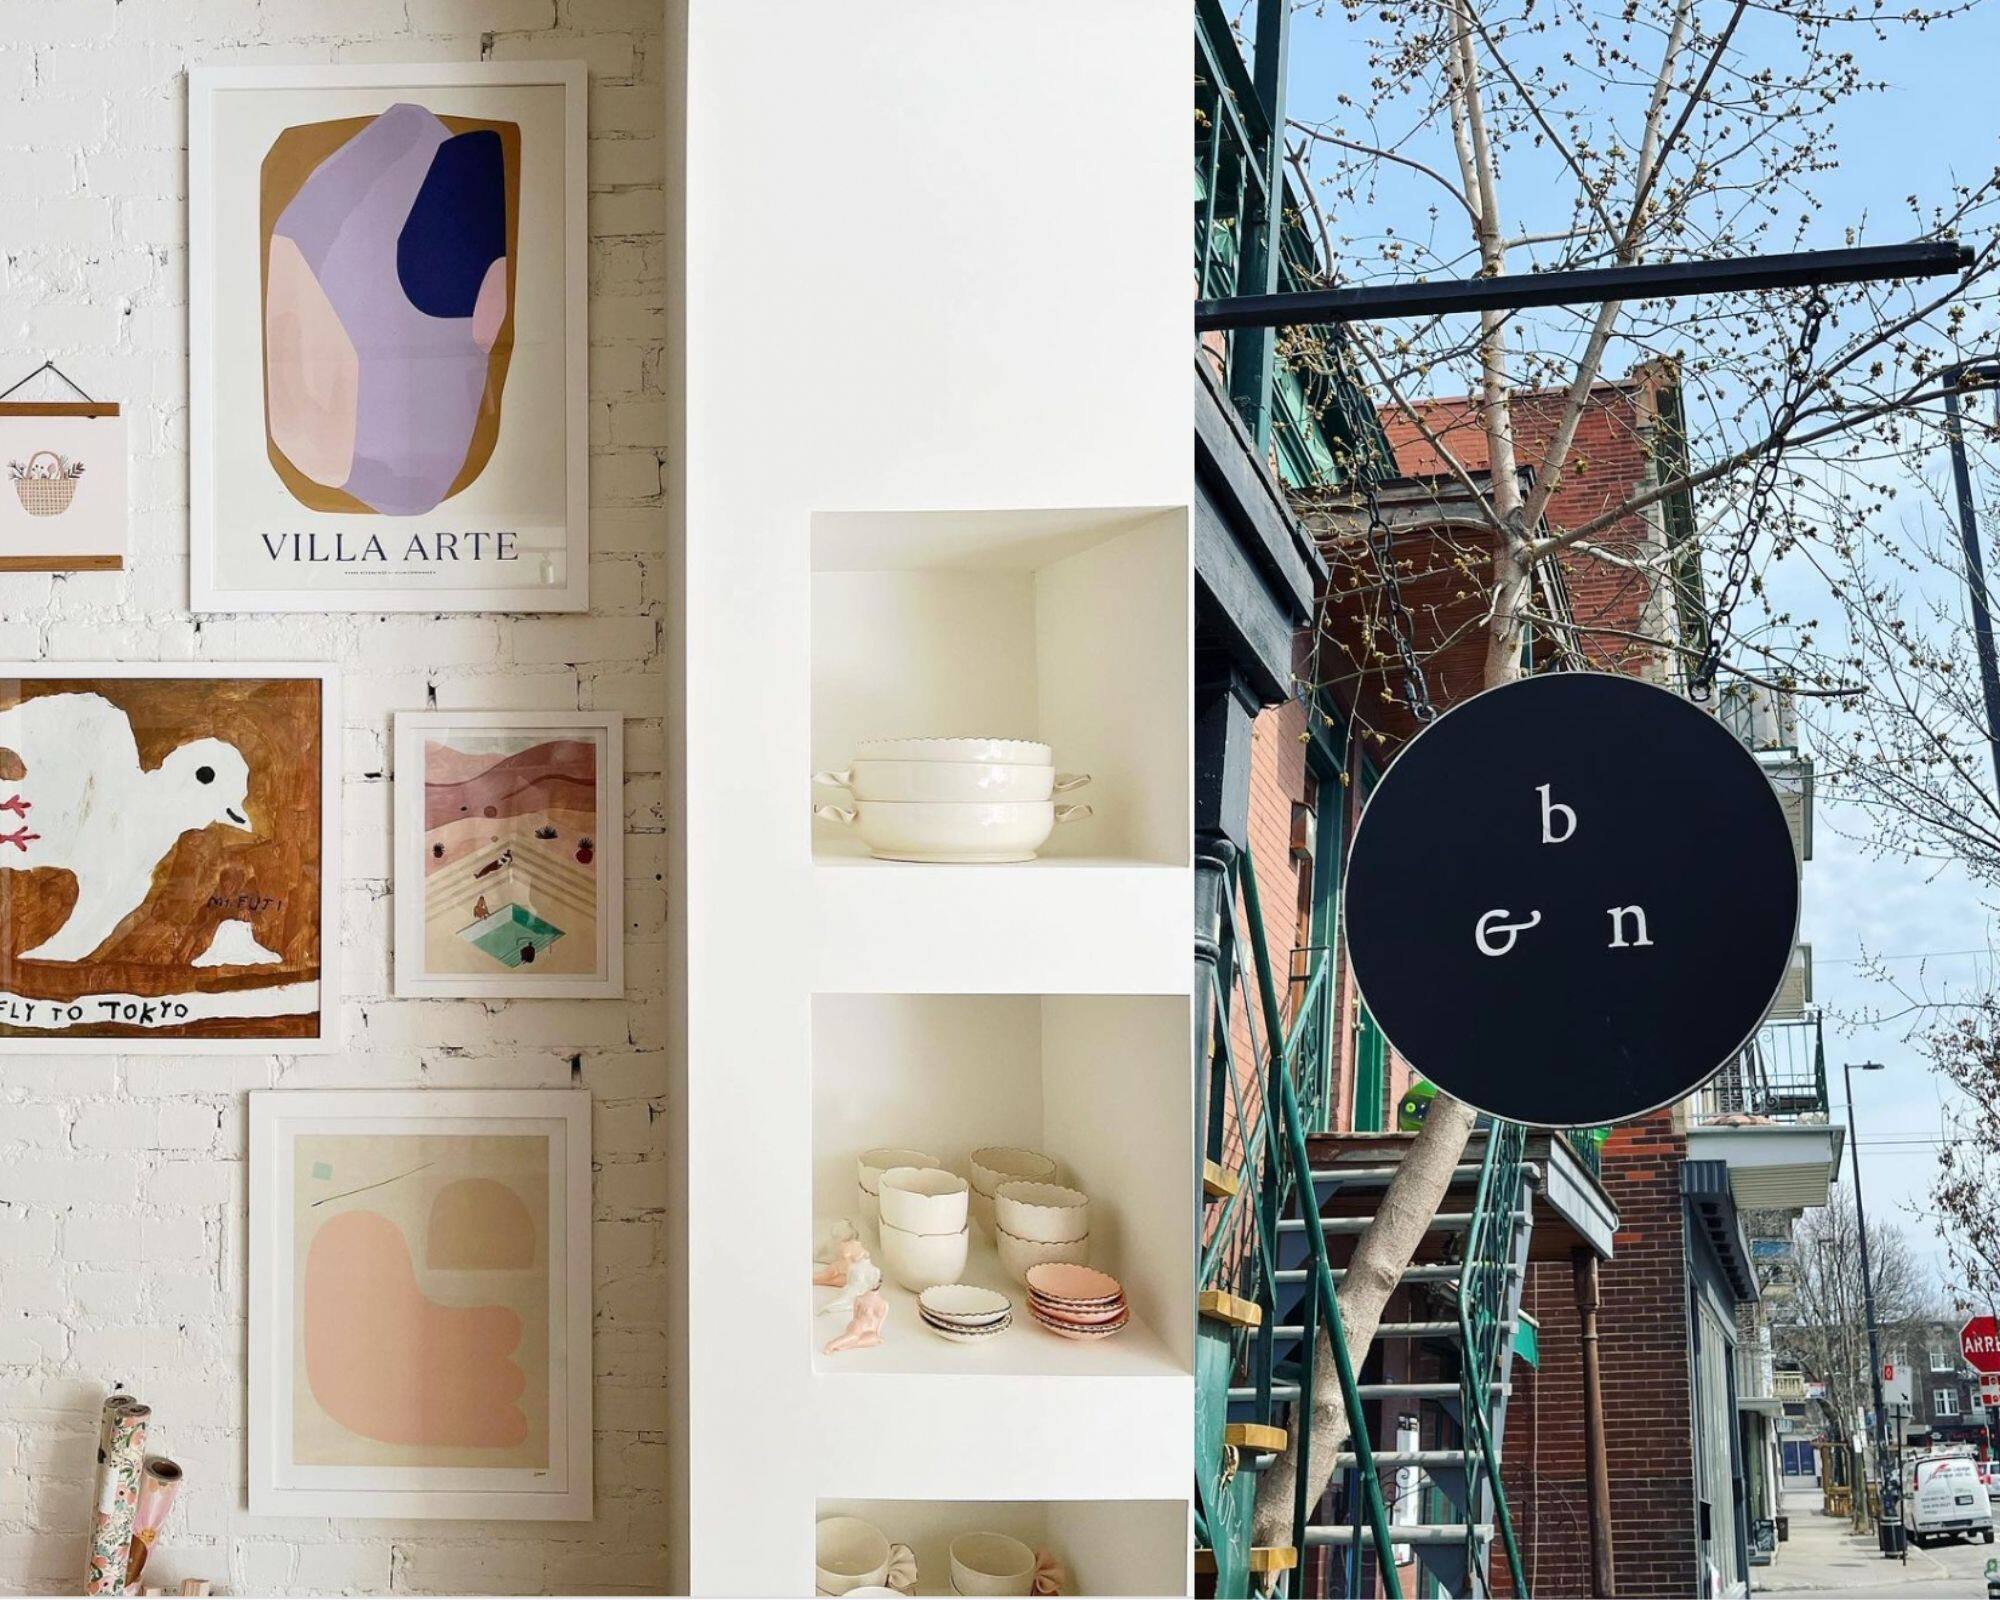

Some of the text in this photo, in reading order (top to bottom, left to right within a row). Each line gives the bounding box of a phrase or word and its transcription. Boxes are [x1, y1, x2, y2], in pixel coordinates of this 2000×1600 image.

[261, 532, 519, 562] VILLA ARTE
[1535, 783, 1577, 844] b
[1475, 905, 1654, 957] & n
[52, 1006, 83, 1022] TO
[98, 1001, 189, 1024] TOKYO
